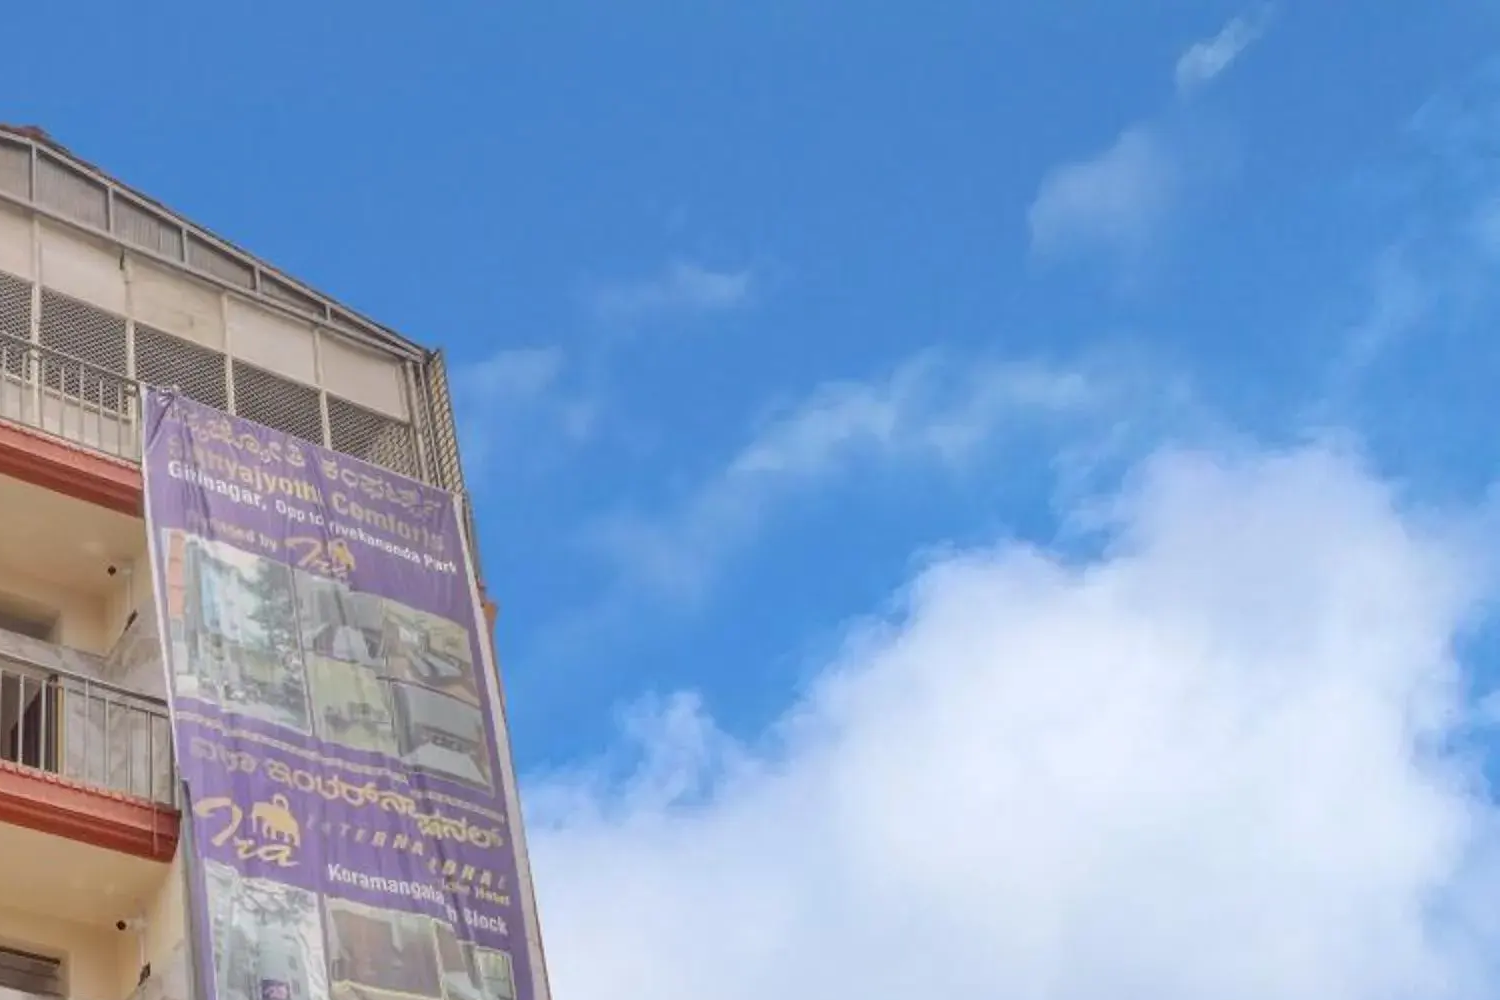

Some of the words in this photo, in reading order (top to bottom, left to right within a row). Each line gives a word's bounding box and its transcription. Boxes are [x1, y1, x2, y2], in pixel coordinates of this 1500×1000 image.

[309, 511, 325, 526] to
[423, 552, 458, 574] Park
[192, 796, 298, 868] Ira
[327, 863, 445, 905] Koramangala
[463, 906, 509, 937] Block
